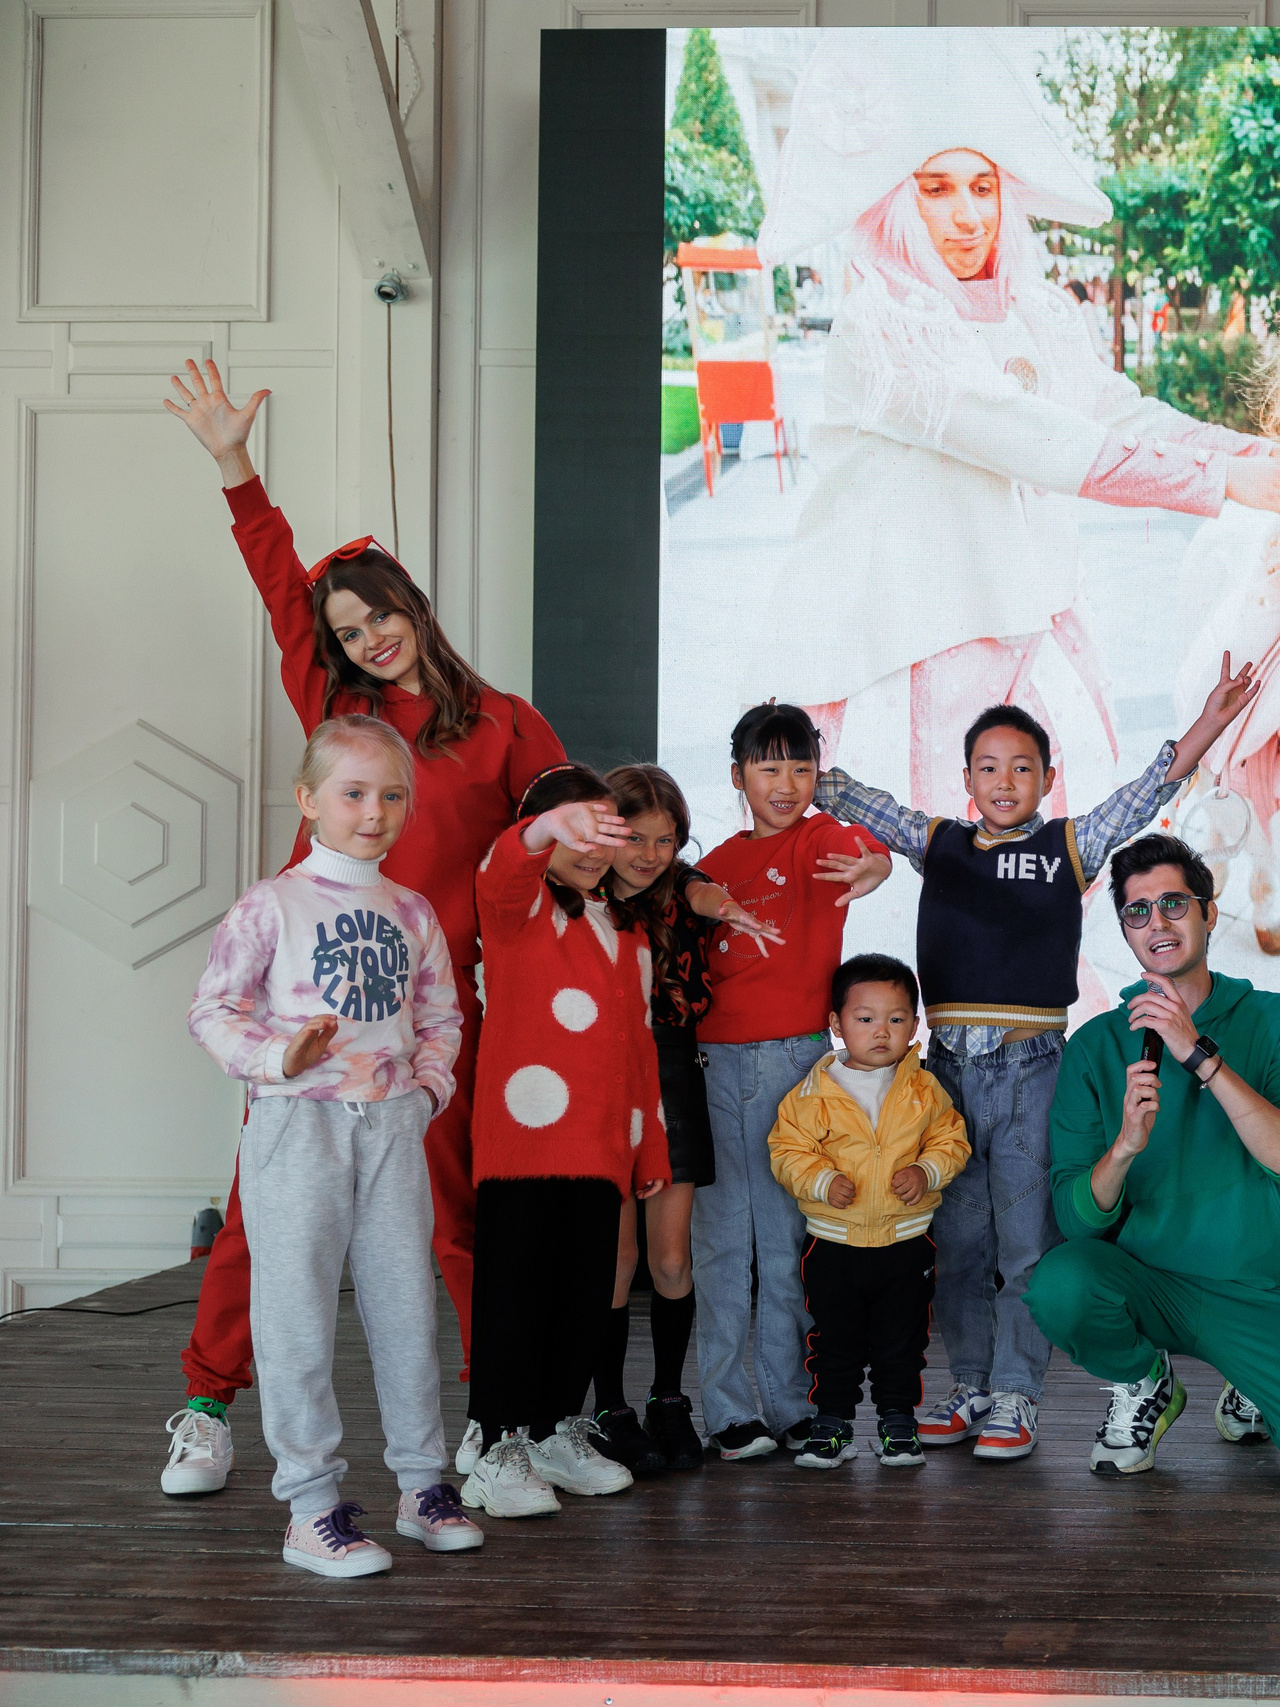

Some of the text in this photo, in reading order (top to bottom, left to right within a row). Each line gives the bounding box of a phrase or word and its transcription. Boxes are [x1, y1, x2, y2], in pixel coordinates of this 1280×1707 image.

[997, 853, 1061, 883] HEY
[316, 909, 392, 947] LOVE
[340, 942, 409, 982] YOUR
